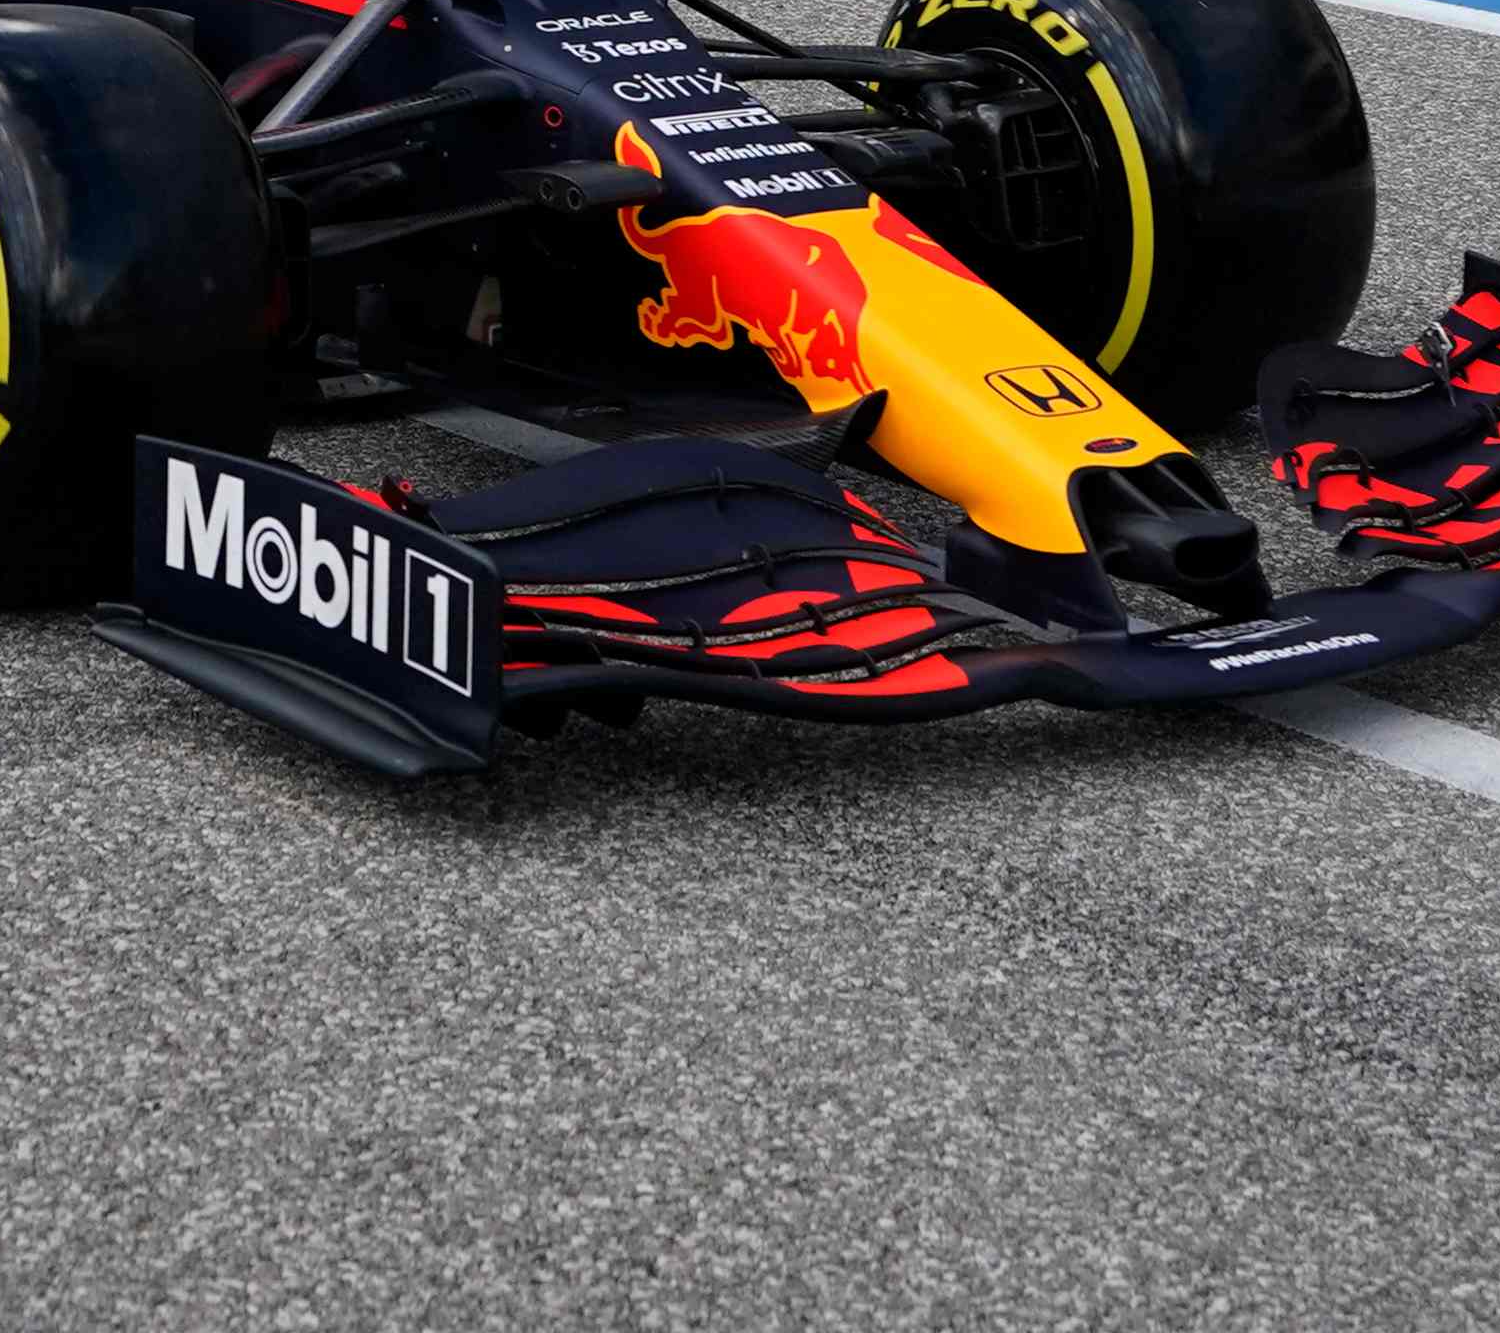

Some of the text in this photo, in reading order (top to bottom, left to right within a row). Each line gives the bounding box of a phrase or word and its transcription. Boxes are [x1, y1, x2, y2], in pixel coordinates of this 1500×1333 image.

[536, 9, 655, 33] ORACLE
[595, 34, 688, 61] Tezos
[612, 66, 738, 103] citrix
[649, 107, 780, 137] PIRELLI
[688, 138, 814, 165] infinitum
[723, 170, 816, 197] Mobil
[166, 456, 391, 654] Mobil
[1209, 632, 1381, 672] #WeRaceAsOne
